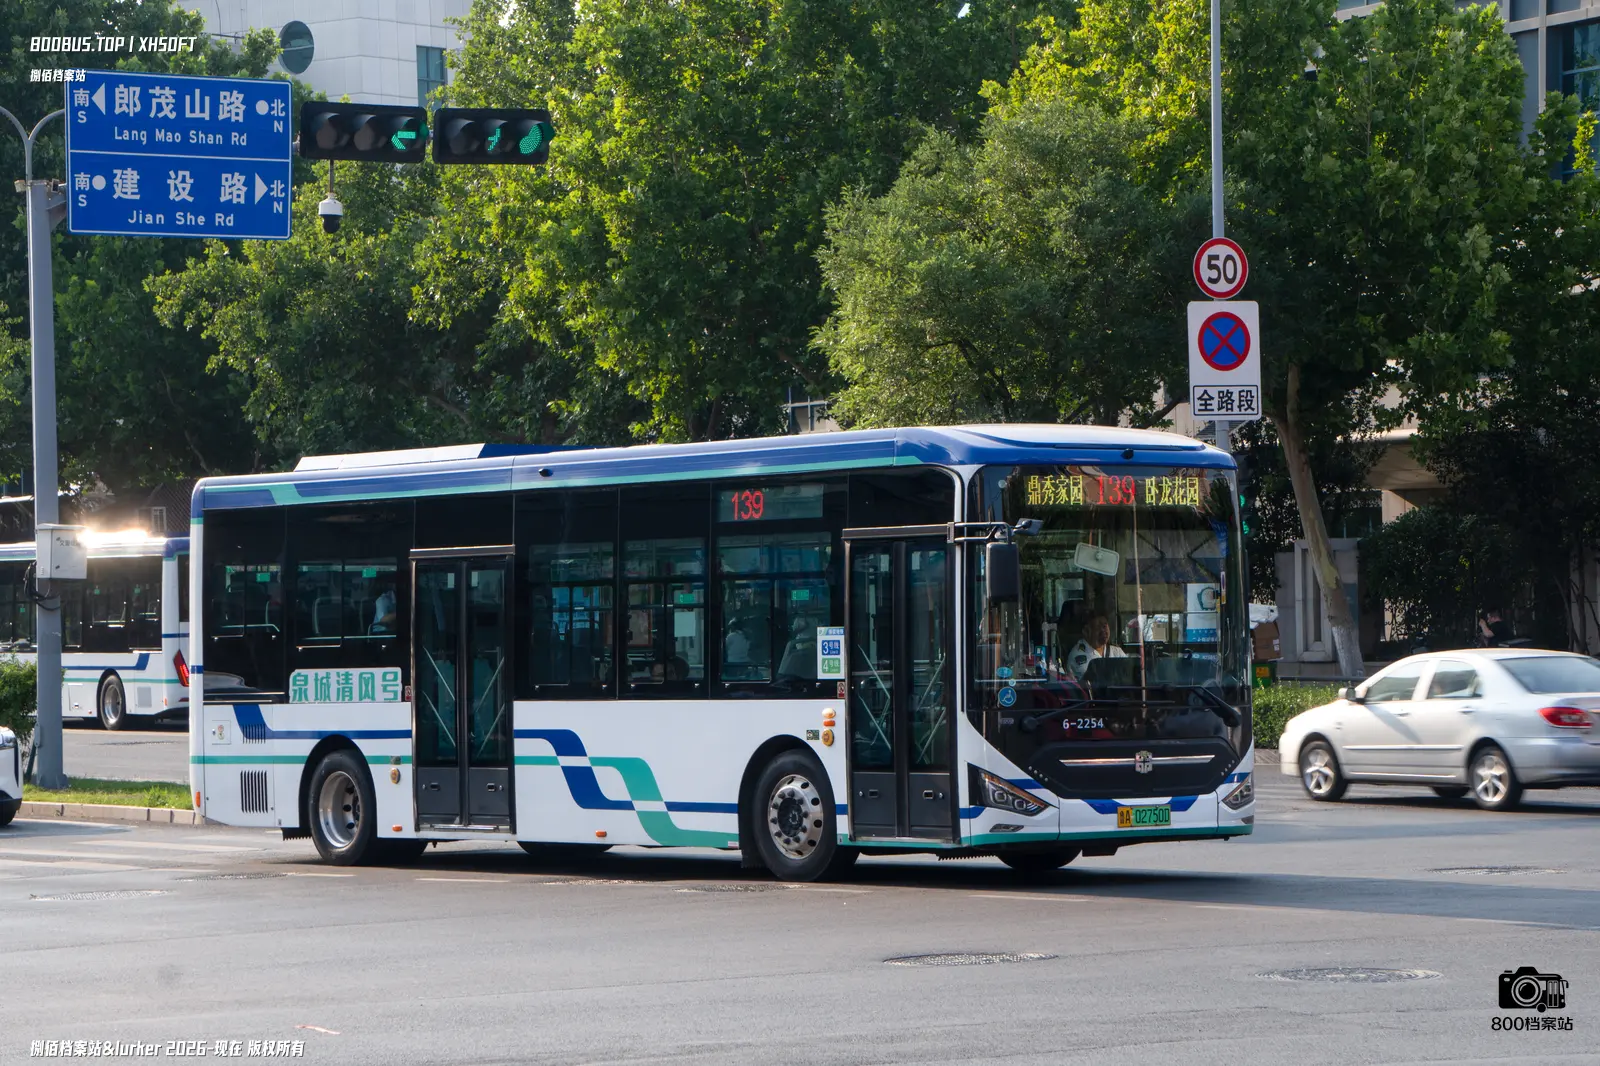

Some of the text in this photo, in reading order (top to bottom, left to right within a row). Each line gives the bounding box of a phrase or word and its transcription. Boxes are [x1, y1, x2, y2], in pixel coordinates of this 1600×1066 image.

[73, 88, 90, 107] 南
[114, 83, 247, 123] 郎茂山路
[77, 111, 87, 124] S
[270, 99, 286, 117] 北
[114, 126, 247, 146] Lang Mao Shan Rd
[273, 120, 283, 133] N
[74, 172, 91, 191] 南
[270, 179, 285, 198] 北
[78, 194, 87, 207] S
[273, 201, 283, 213] N
[128, 210, 234, 227] Jian She Rd
[1207, 254, 1238, 285] 50
[1196, 389, 1256, 413] 全路段
[1027, 475, 1200, 506] 鼎秀家园 139 卧龙花园
[731, 490, 764, 521] 139
[291, 671, 400, 702] 泉城清风号
[1062, 717, 1104, 730] 6-2254
